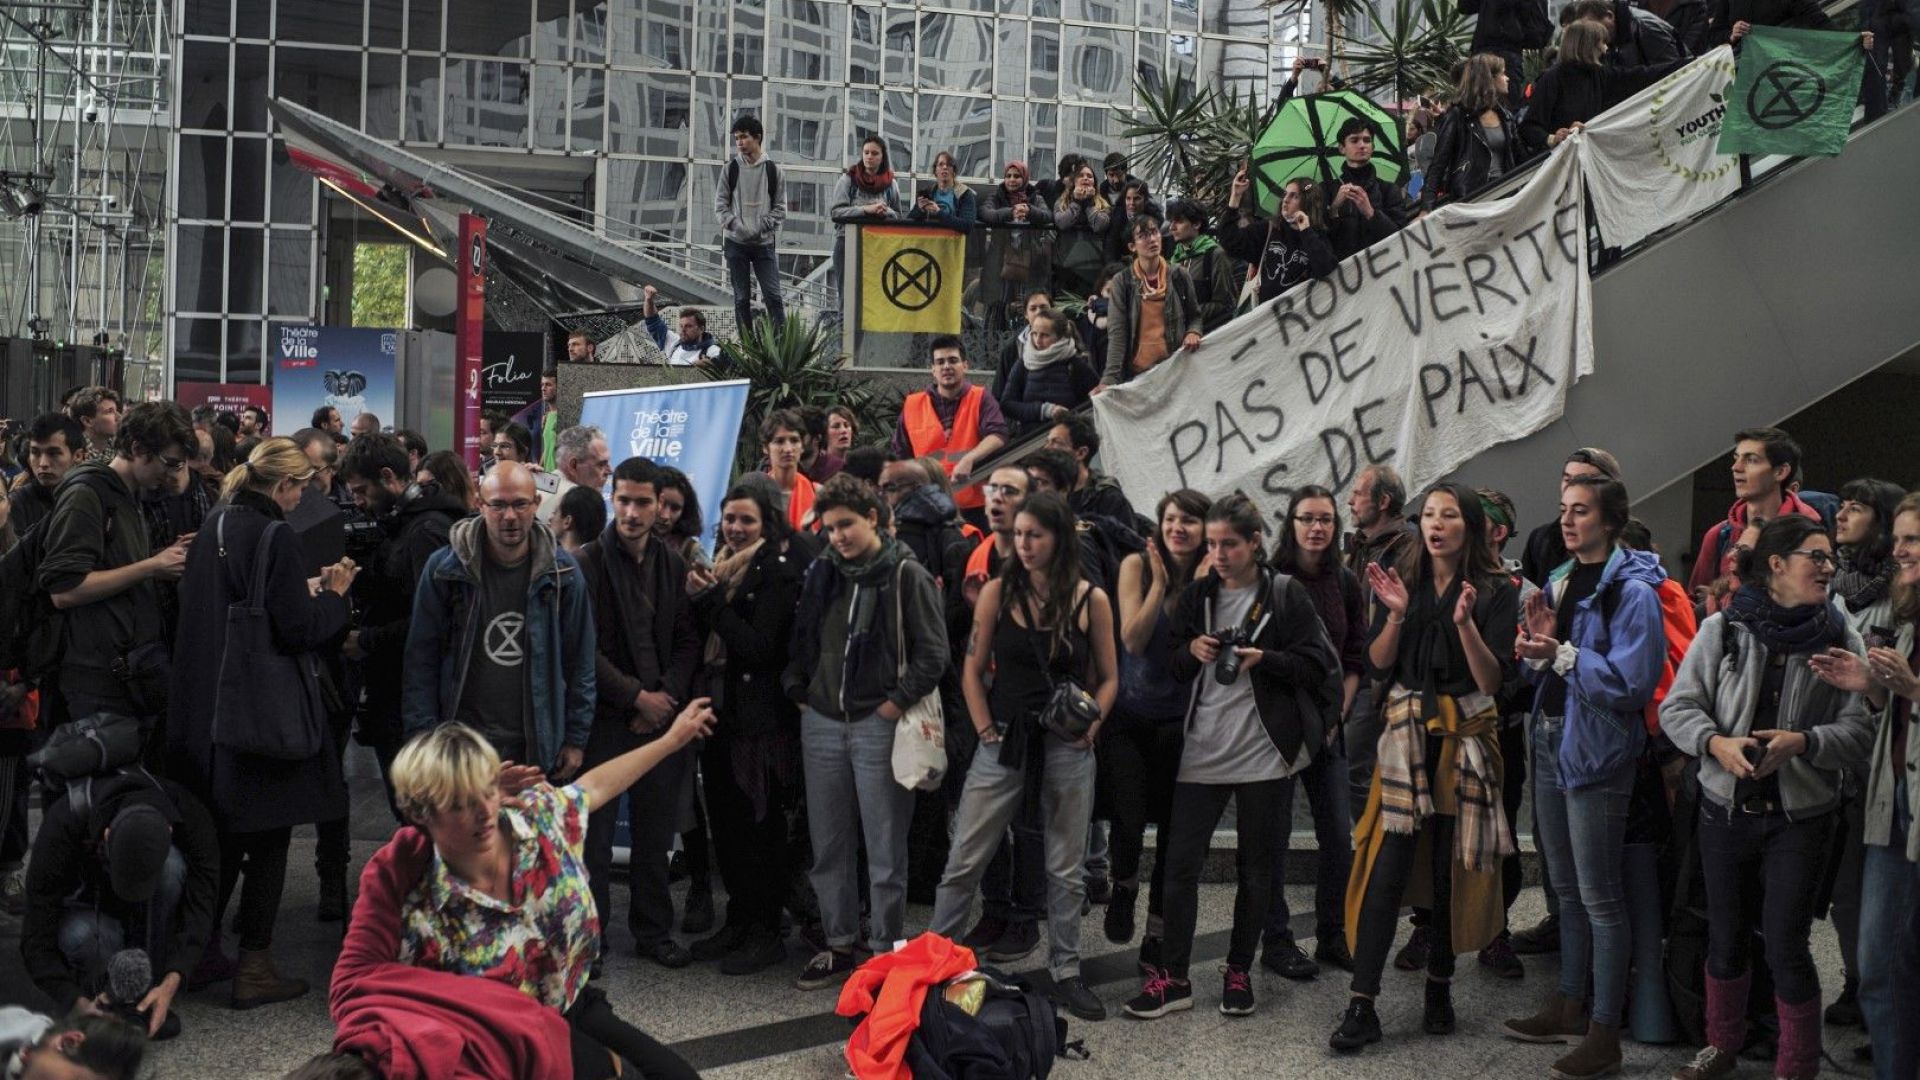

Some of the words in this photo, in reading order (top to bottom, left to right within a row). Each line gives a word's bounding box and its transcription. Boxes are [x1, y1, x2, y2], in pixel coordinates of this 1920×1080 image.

[1676, 104, 1726, 138] YOUTH
[1271, 218, 1433, 346] ROUEN
[281, 336, 295, 346] de
[297, 337, 307, 346] la
[281, 344, 318, 358] Ville
[1168, 378, 1285, 490] PAS
[1298, 319, 1376, 404] DE
[634, 409, 688, 425] Théâtre
[631, 424, 651, 439] de
[654, 423, 670, 437] la
[630, 438, 682, 457] Ville
[1318, 399, 1396, 495] DE
